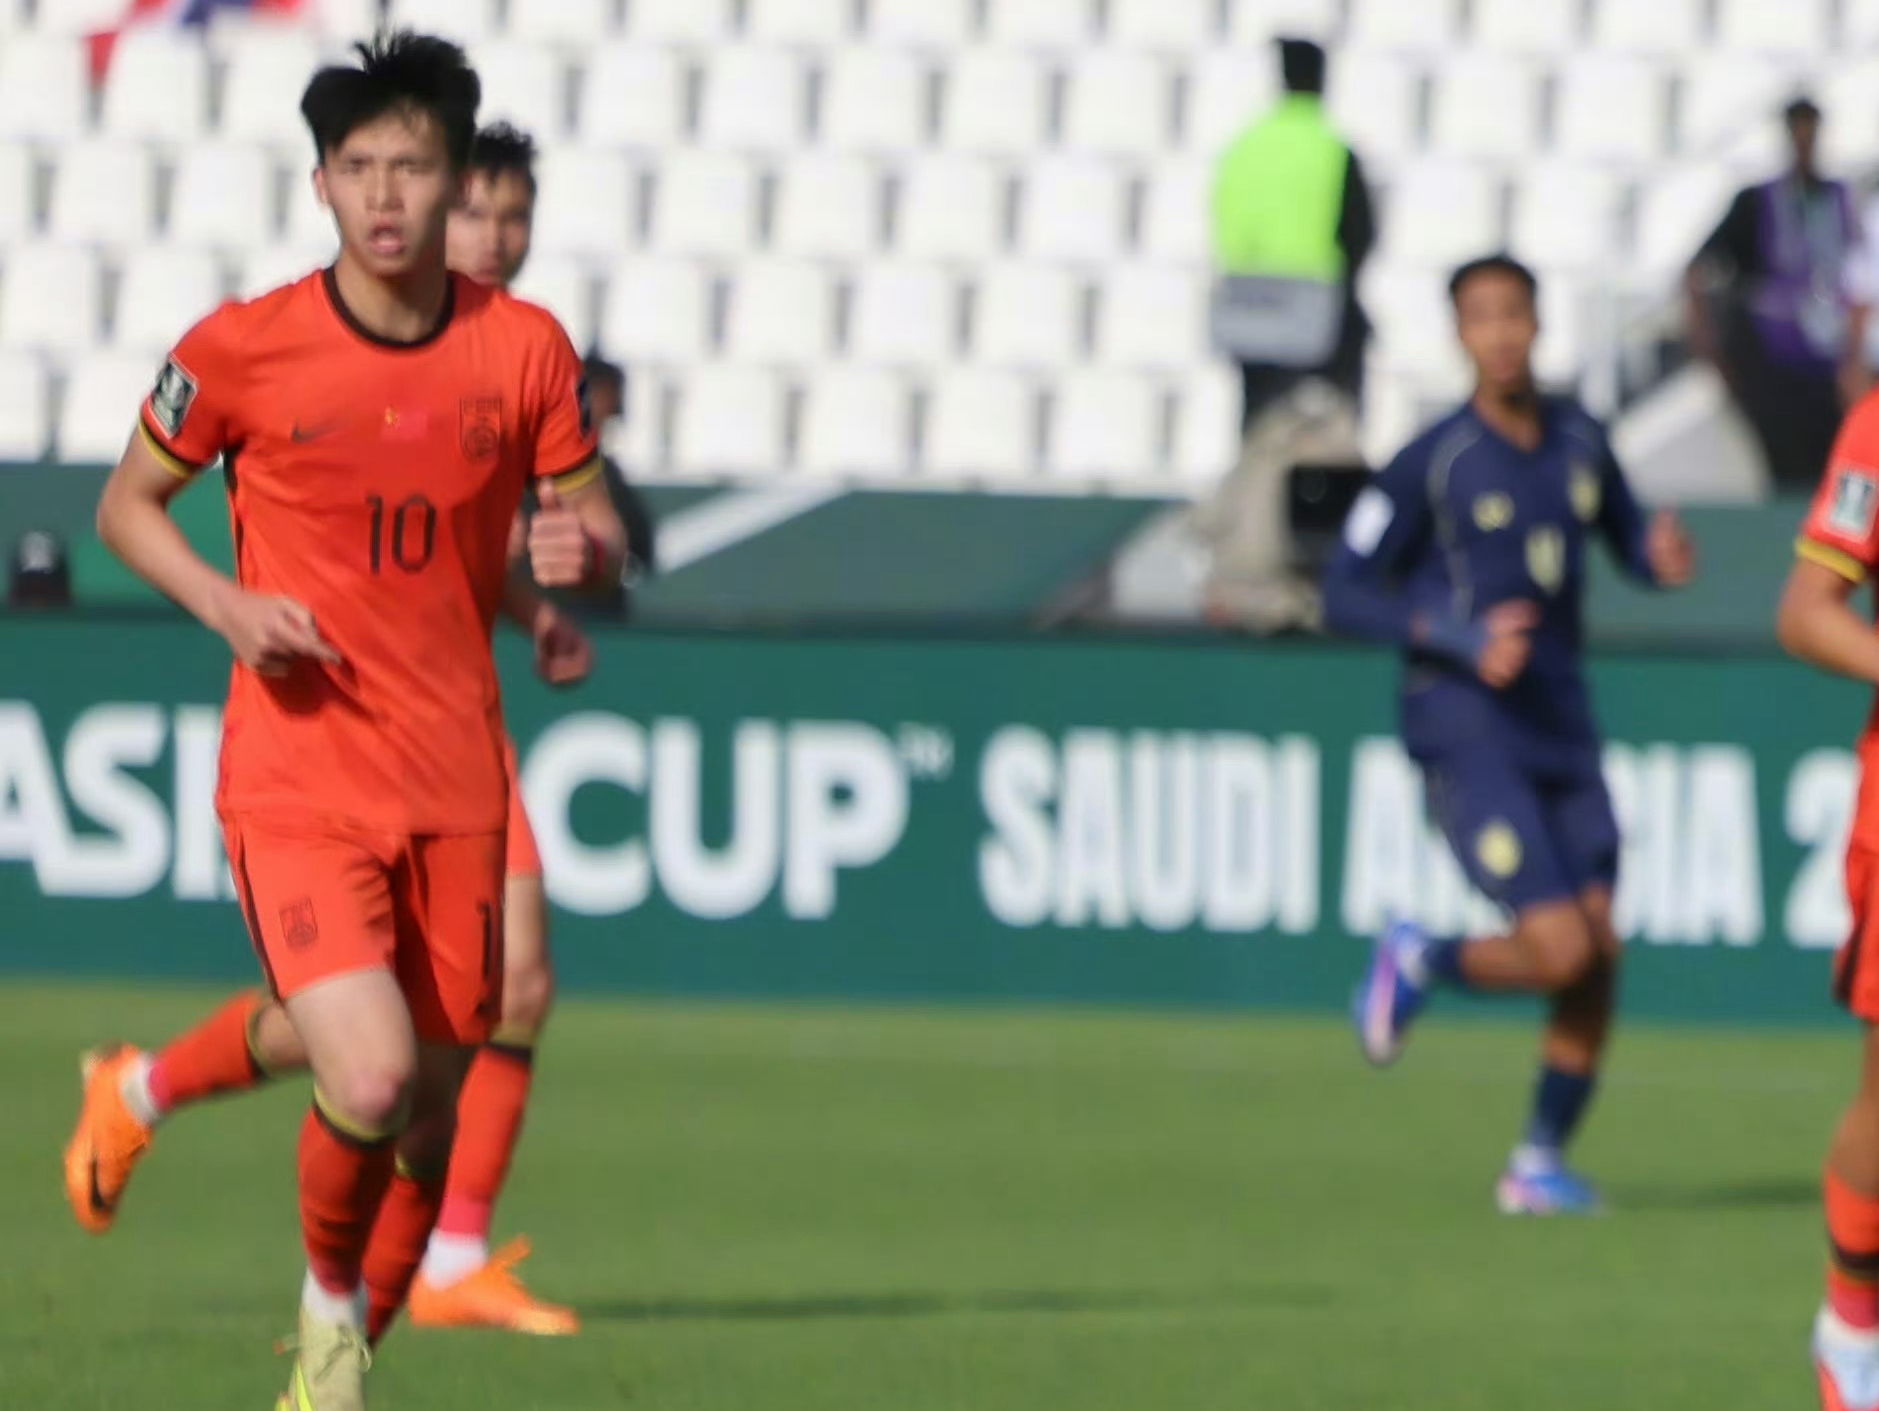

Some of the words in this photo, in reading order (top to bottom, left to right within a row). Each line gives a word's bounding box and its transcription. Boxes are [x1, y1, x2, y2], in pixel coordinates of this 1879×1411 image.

[365, 492, 438, 576] 10
[0, 698, 240, 902] ASI
[979, 724, 1322, 930] SAUDI
